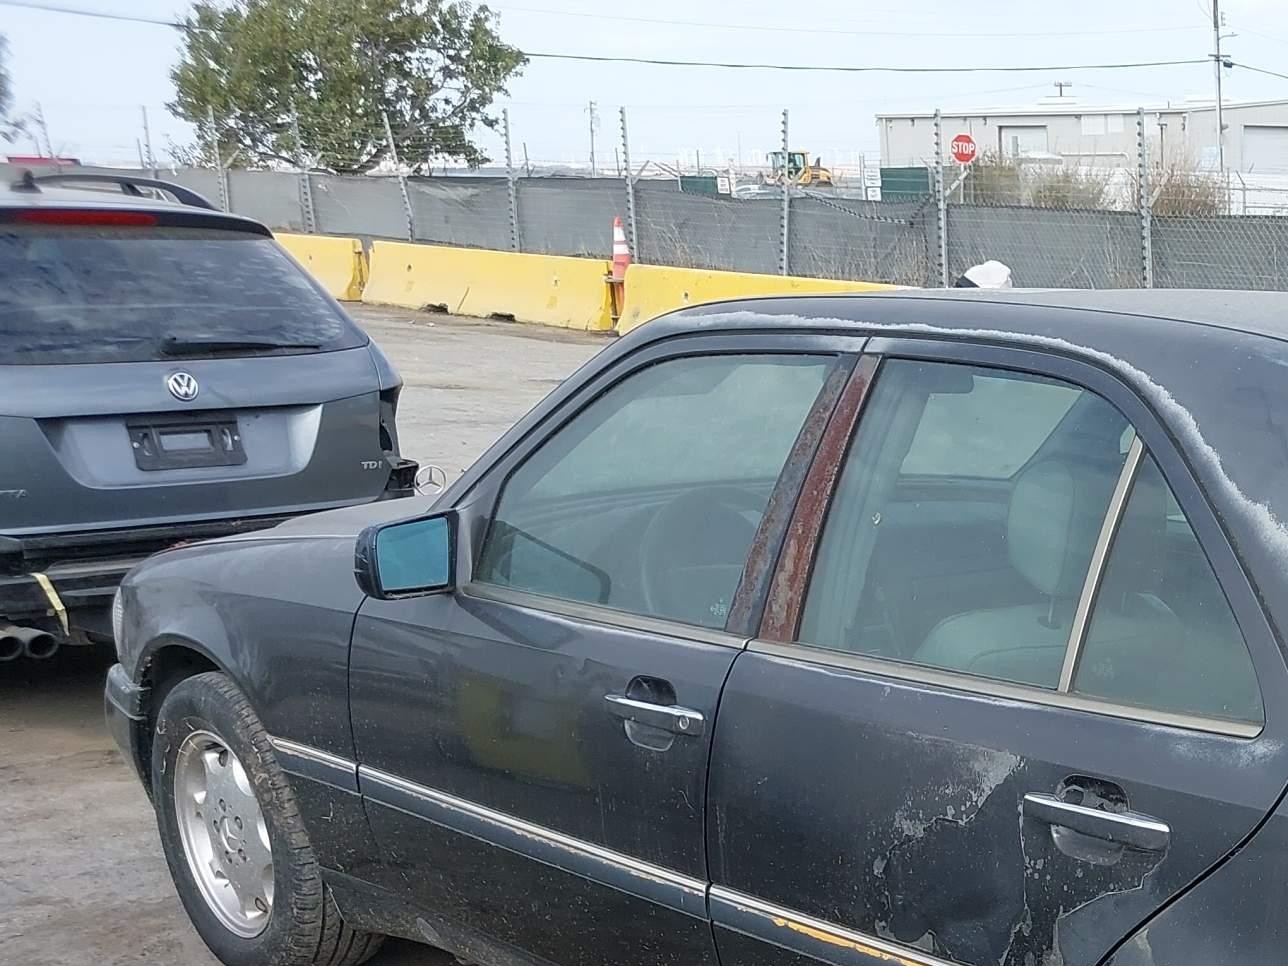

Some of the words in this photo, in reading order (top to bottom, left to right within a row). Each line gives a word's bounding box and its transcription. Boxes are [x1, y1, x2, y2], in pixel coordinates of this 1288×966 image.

[951, 141, 975, 154] STOP
[168, 372, 198, 400] VW
[360, 460, 383, 470] TDI
